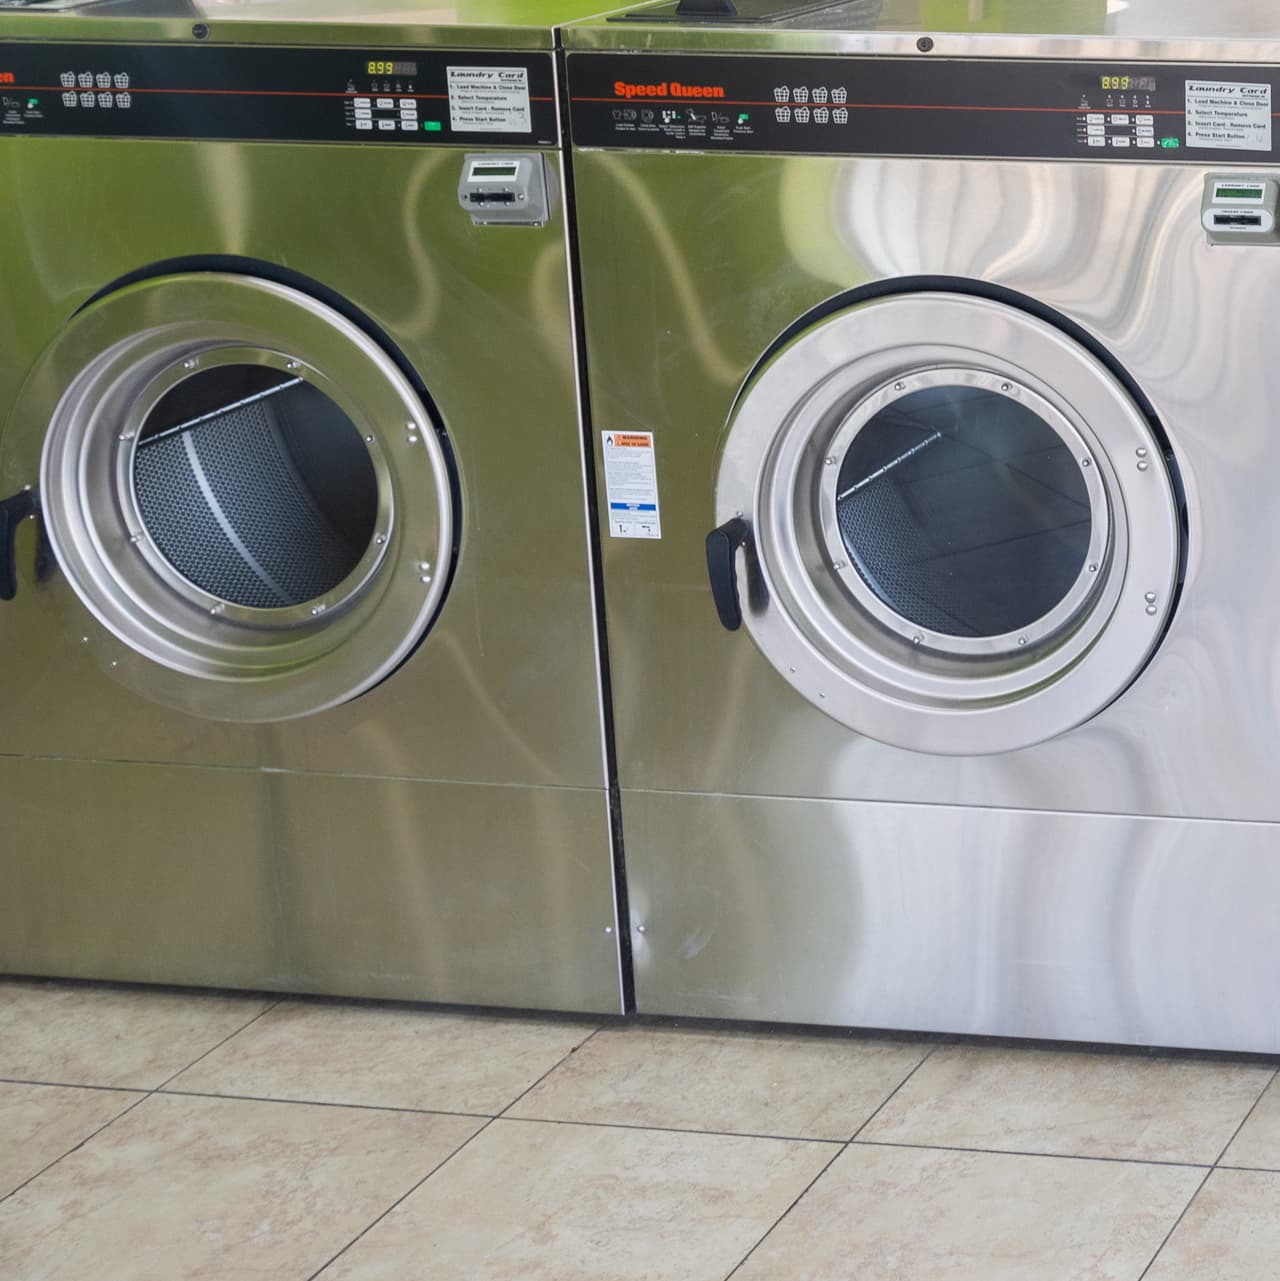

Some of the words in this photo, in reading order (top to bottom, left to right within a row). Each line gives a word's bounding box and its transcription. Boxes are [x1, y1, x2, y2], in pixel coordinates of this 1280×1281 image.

[614, 81, 667, 99] Speed
[670, 83, 724, 98] Queen
[1189, 85, 1235, 93] Laundry
